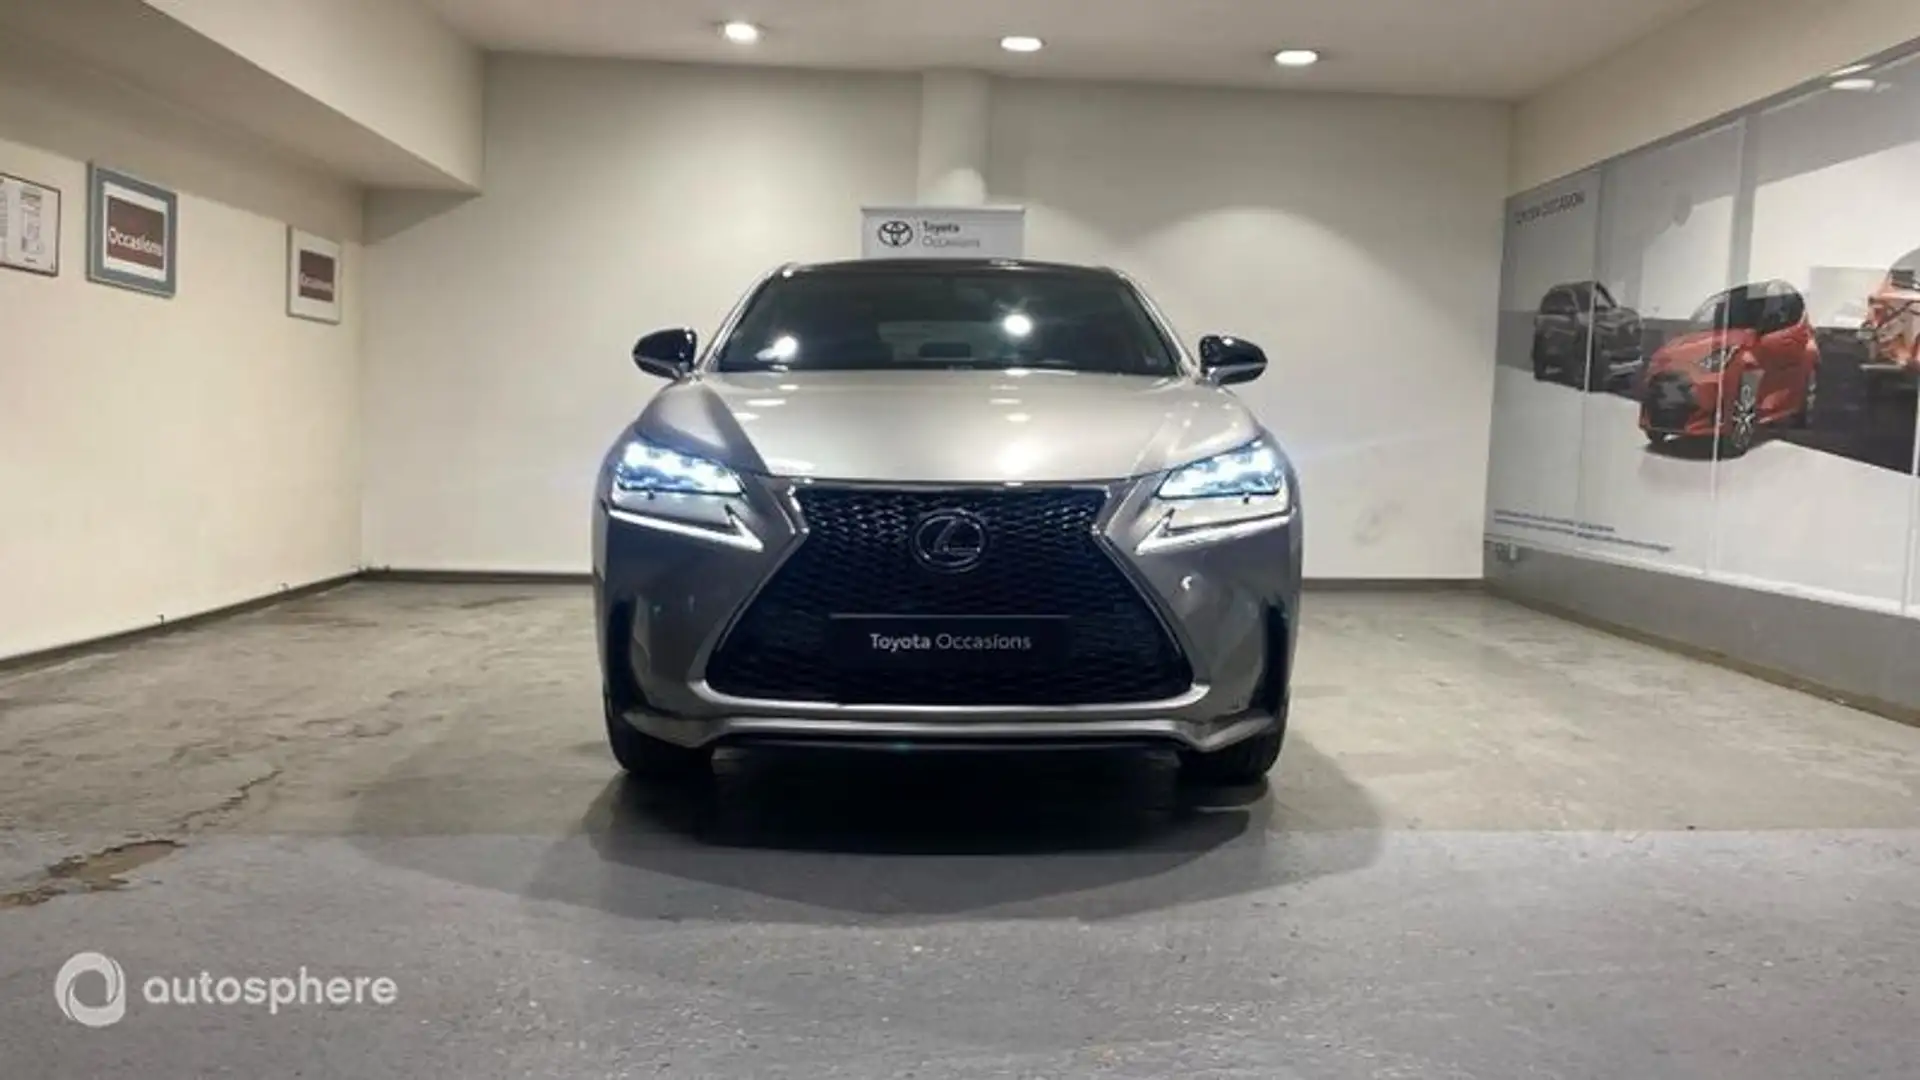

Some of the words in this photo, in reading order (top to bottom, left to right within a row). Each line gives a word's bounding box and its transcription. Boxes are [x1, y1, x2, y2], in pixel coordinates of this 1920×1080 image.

[922, 220, 961, 235] Toyota
[108, 226, 163, 257] Occasions
[869, 633, 931, 652] Toyota
[936, 633, 1032, 650] Occasions
